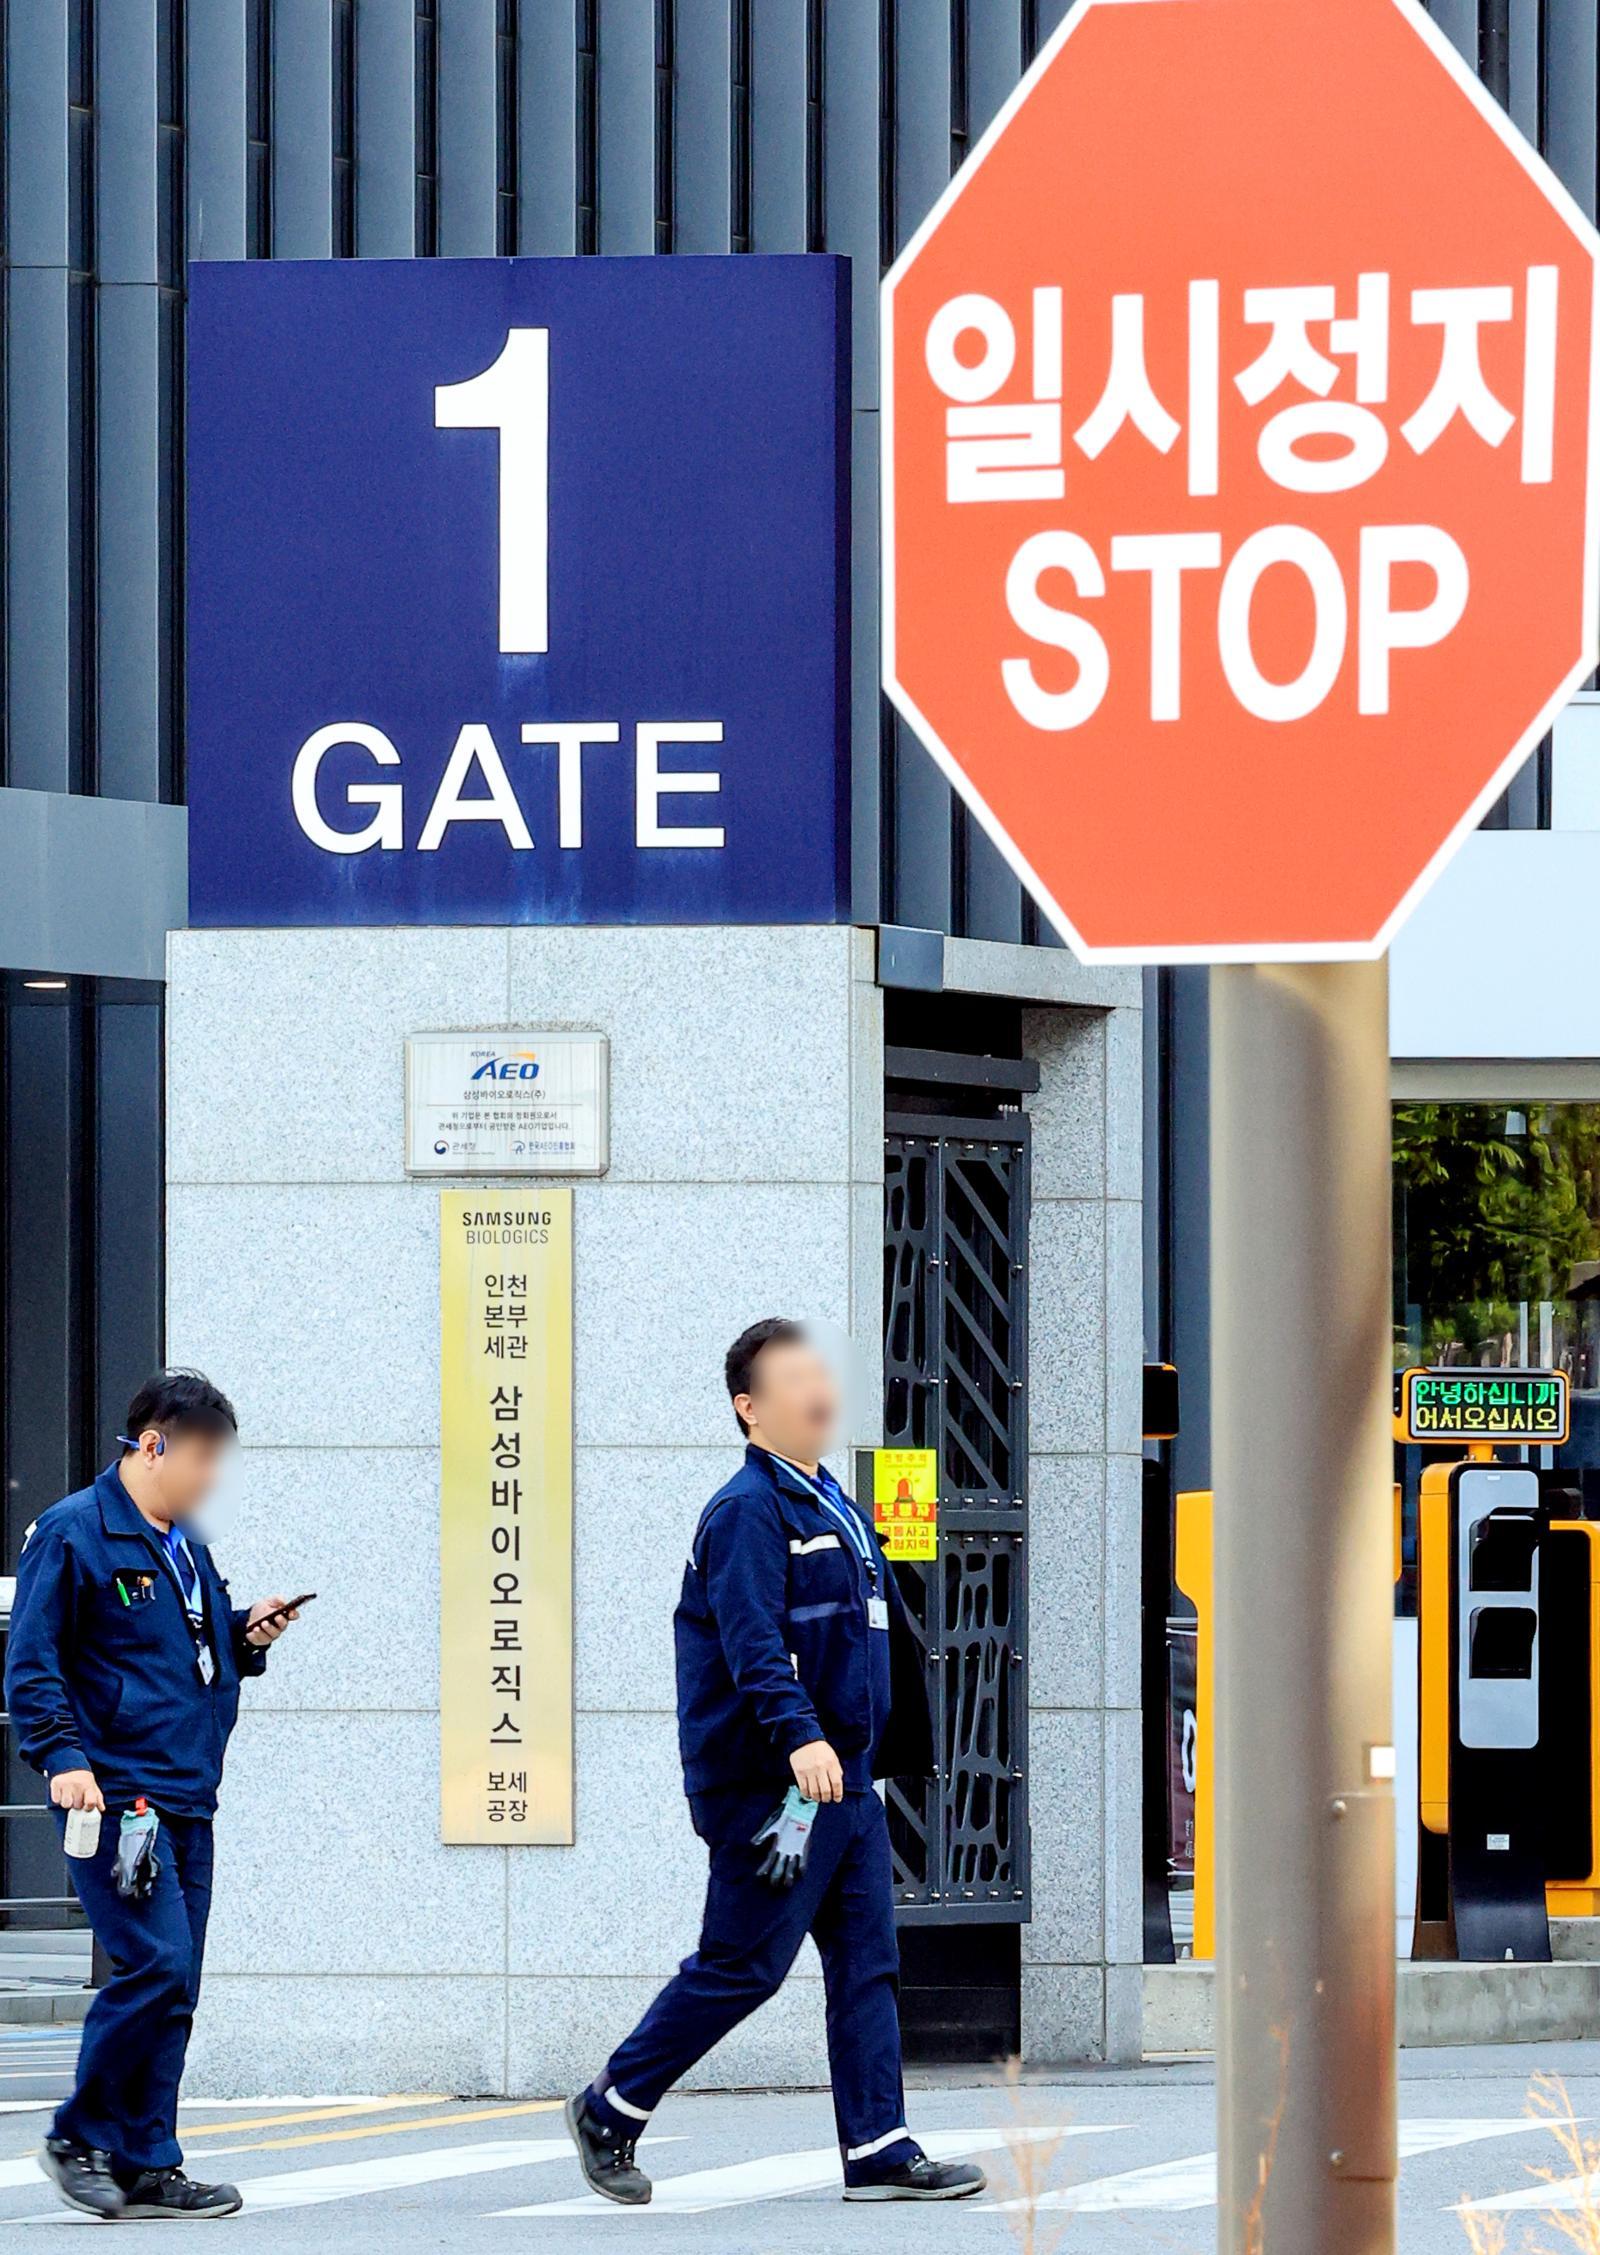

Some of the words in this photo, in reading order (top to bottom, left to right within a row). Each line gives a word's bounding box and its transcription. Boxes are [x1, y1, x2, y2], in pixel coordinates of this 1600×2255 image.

[925, 265, 1559, 504] 일시정지
[434, 327, 549, 653] 1
[1001, 524, 1470, 731] STOP
[291, 721, 725, 853] GATE
[470, 1056, 540, 1080] AEO
[462, 1211, 552, 1227] SAMSUNG
[466, 1229, 549, 1245] BIOLOGICS
[484, 1274, 528, 1298] 인천
[484, 1305, 528, 1328] 본부
[484, 1336, 528, 1359] 세관
[1416, 1381, 1560, 1406] 안녕하십니까
[1416, 1406, 1558, 1431] 어서오십시오
[489, 1385, 523, 1744] 삼성바이오로직스
[487, 1771, 528, 1793] 보세
[486, 1799, 528, 1822] 공장
